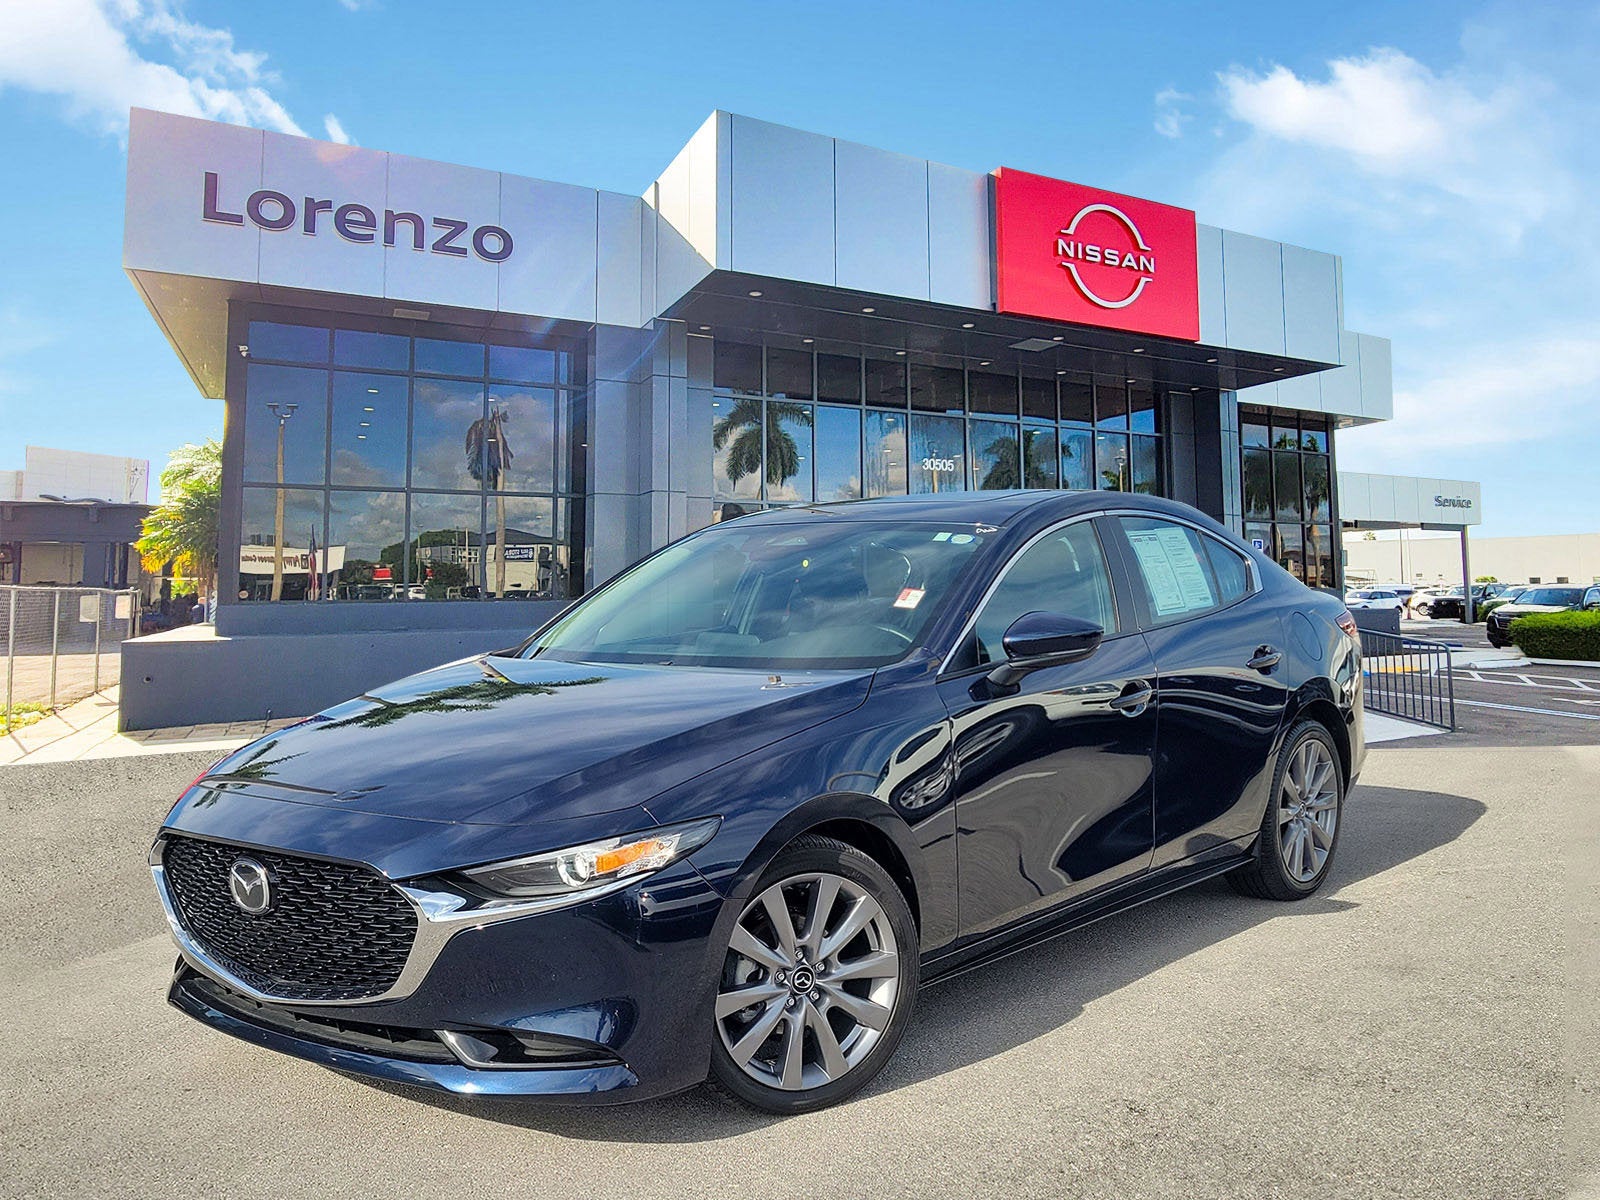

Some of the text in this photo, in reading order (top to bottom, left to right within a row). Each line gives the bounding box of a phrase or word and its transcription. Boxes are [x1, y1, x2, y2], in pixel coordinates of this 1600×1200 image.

[202, 171, 514, 262] Lorenzo
[1057, 238, 1155, 273] NISSAN
[922, 458, 954, 471] 30505
[1434, 496, 1472, 508] Service
